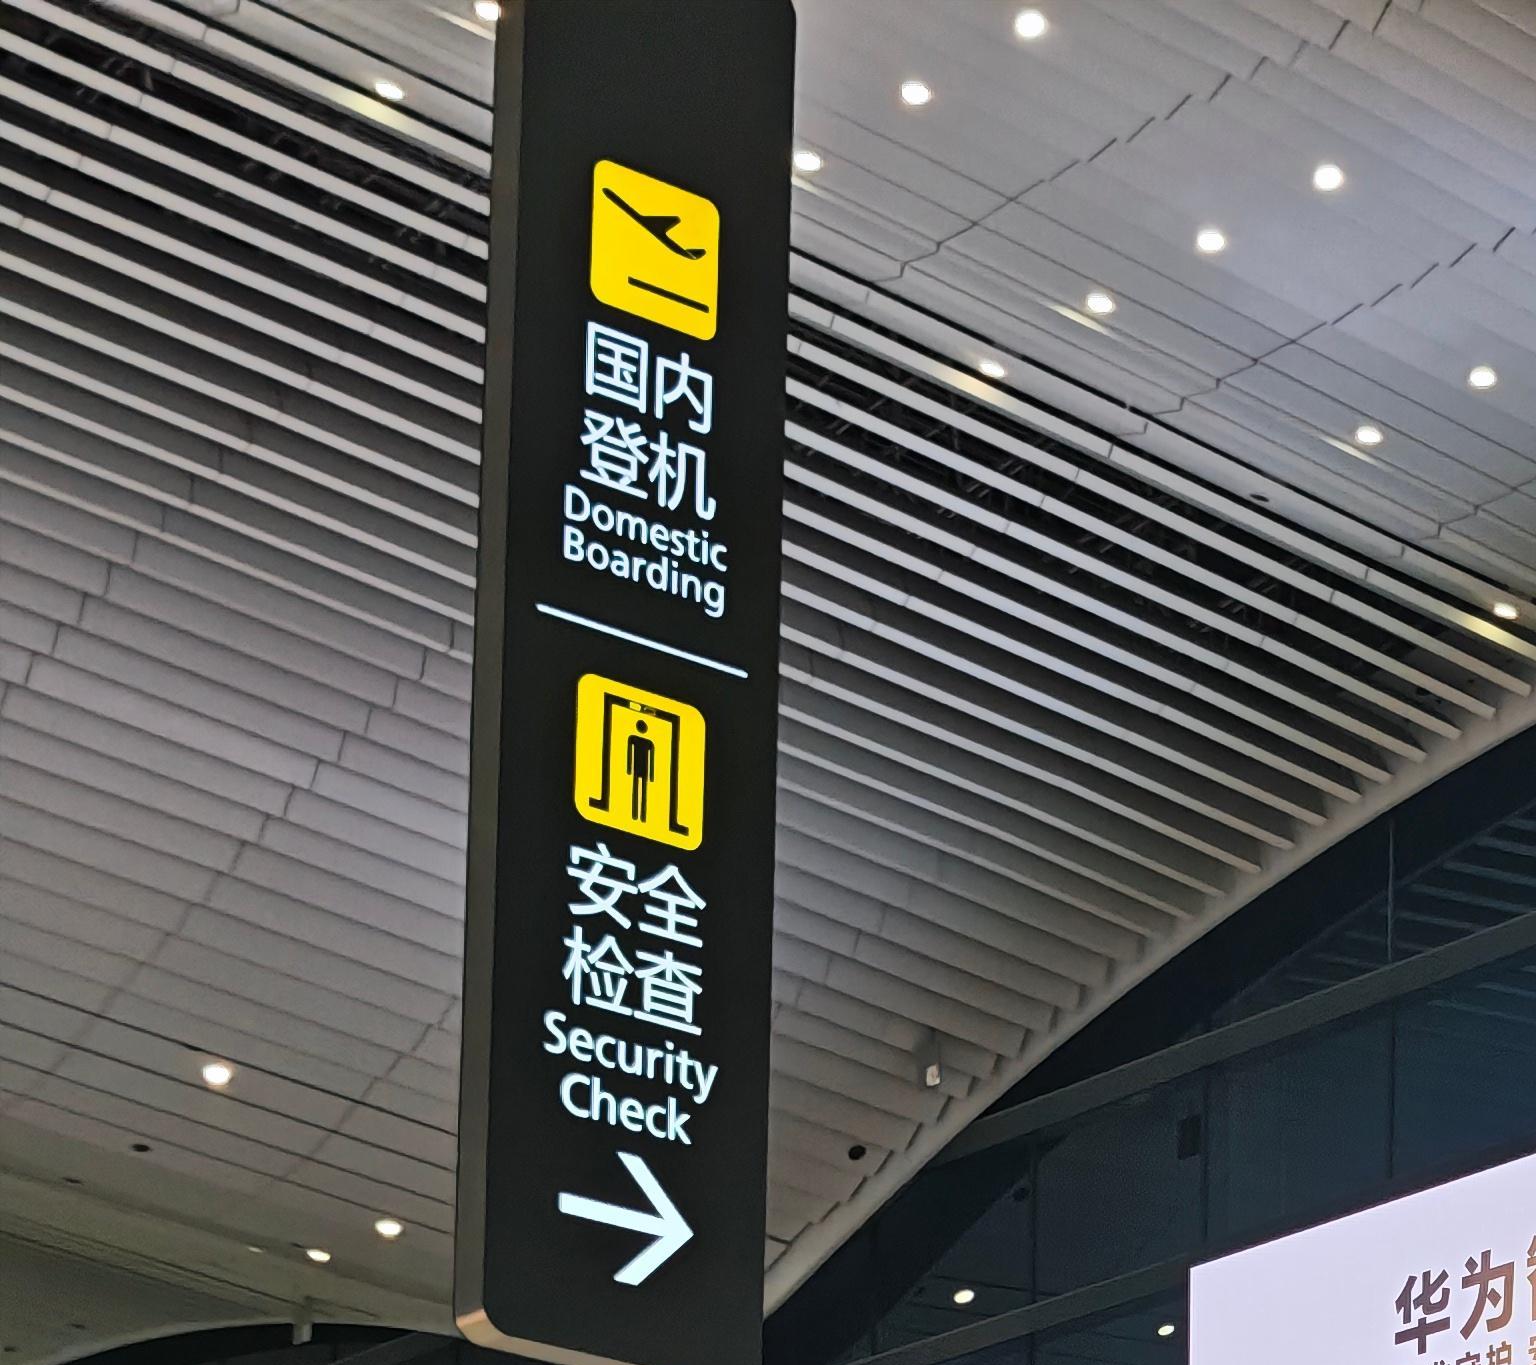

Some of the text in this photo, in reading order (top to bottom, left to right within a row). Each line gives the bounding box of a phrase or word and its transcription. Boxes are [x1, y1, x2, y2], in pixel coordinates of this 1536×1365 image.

[584, 321, 714, 434] 国内
[579, 408, 717, 521] 登机
[562, 523, 726, 619] Boarding
[563, 483, 728, 573] Domestic
[566, 842, 707, 949] 安全
[562, 925, 703, 1036] 检查
[543, 1010, 719, 1105] Security
[559, 1074, 692, 1146] Check
